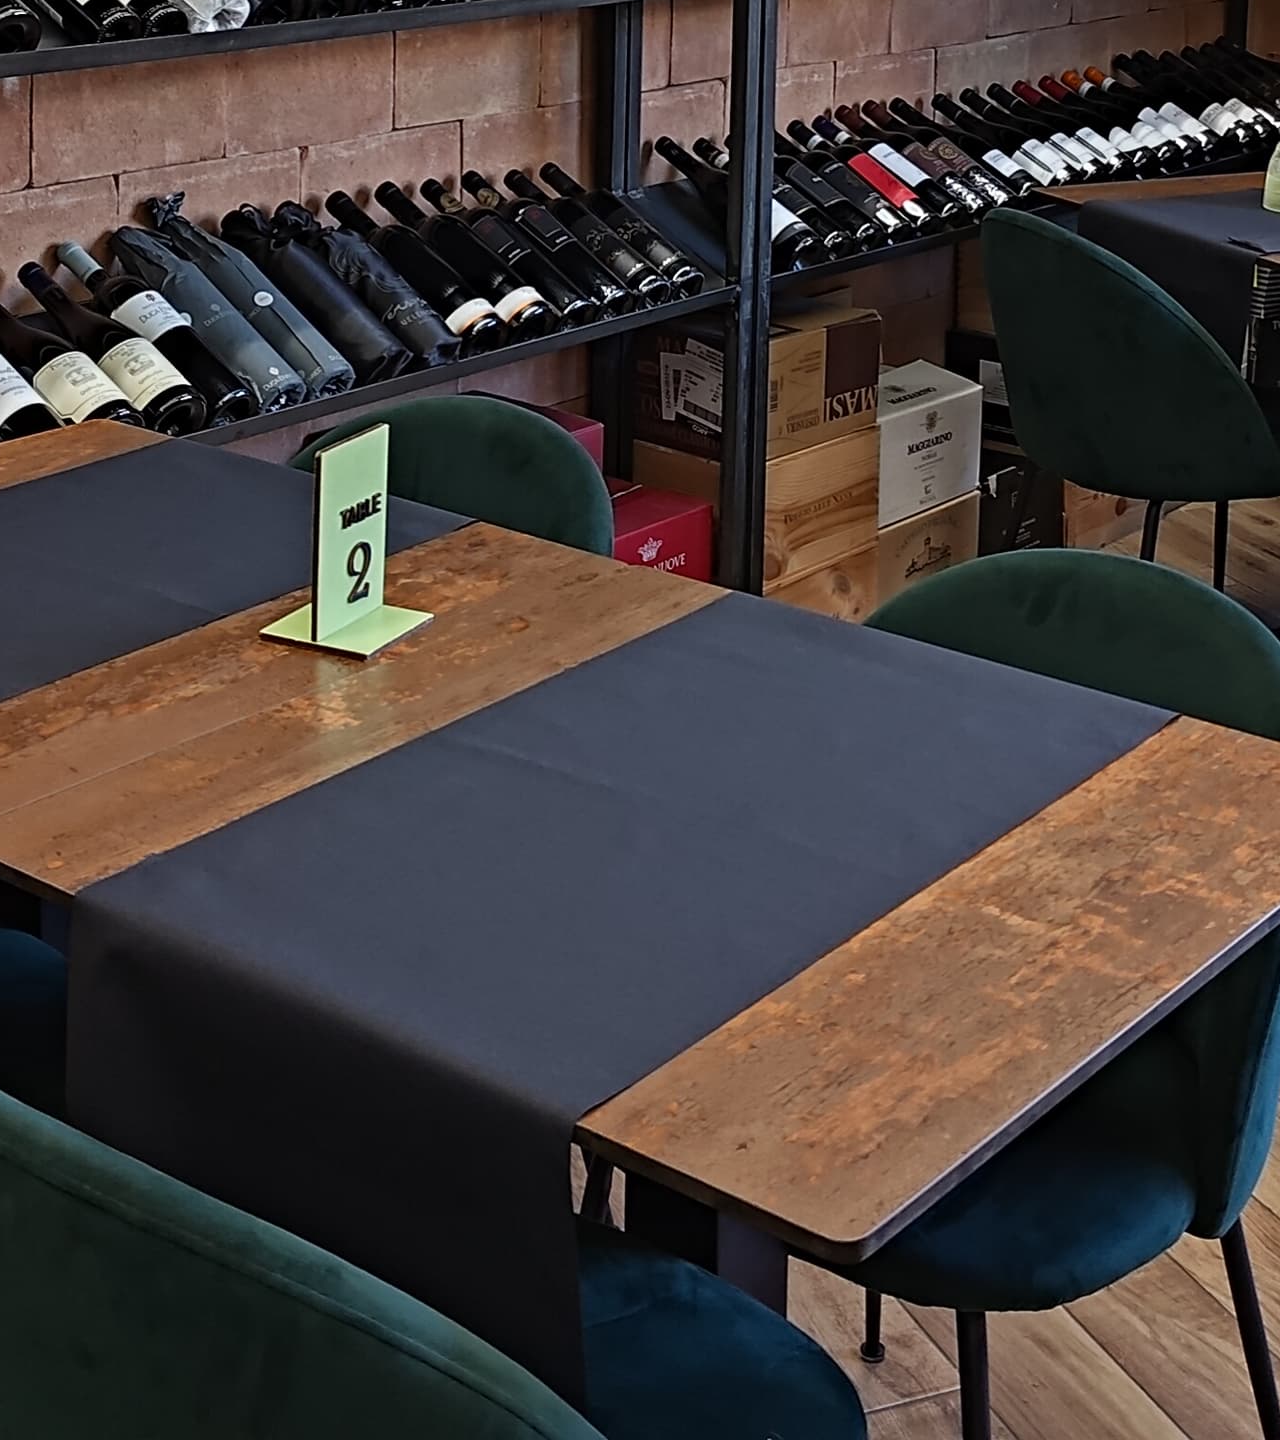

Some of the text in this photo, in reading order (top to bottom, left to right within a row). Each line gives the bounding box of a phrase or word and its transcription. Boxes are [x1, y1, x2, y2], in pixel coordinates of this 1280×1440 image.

[824, 385, 879, 423] MASI
[338, 492, 382, 530] TABLE
[346, 541, 372, 604] 2
